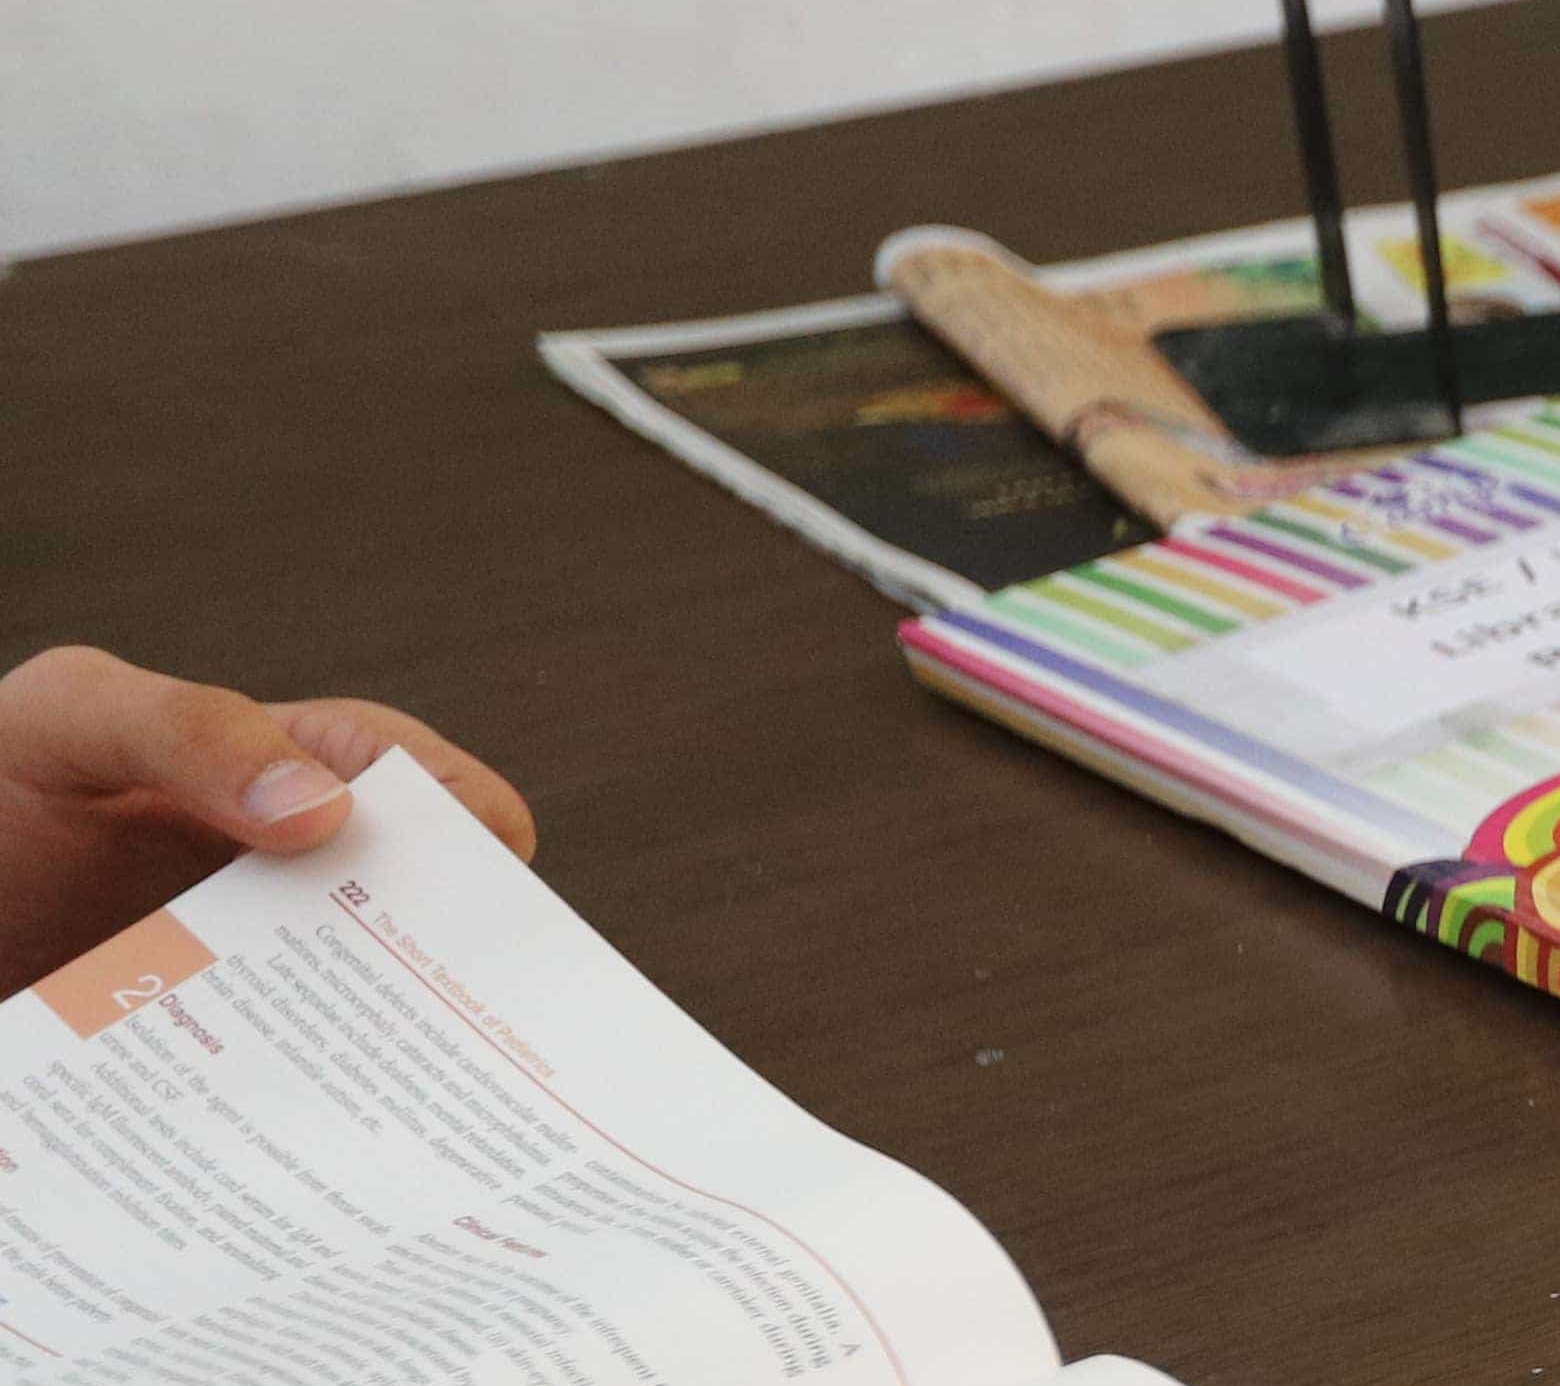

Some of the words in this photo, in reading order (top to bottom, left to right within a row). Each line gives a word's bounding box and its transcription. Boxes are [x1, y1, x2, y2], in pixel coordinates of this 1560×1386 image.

[337, 879, 372, 909] 222
[372, 910, 399, 938] The
[395, 933, 435, 969] Short
[429, 963, 487, 1017] Textbook
[112, 973, 163, 1013] 2
[158, 992, 227, 1059] Diagnosis
